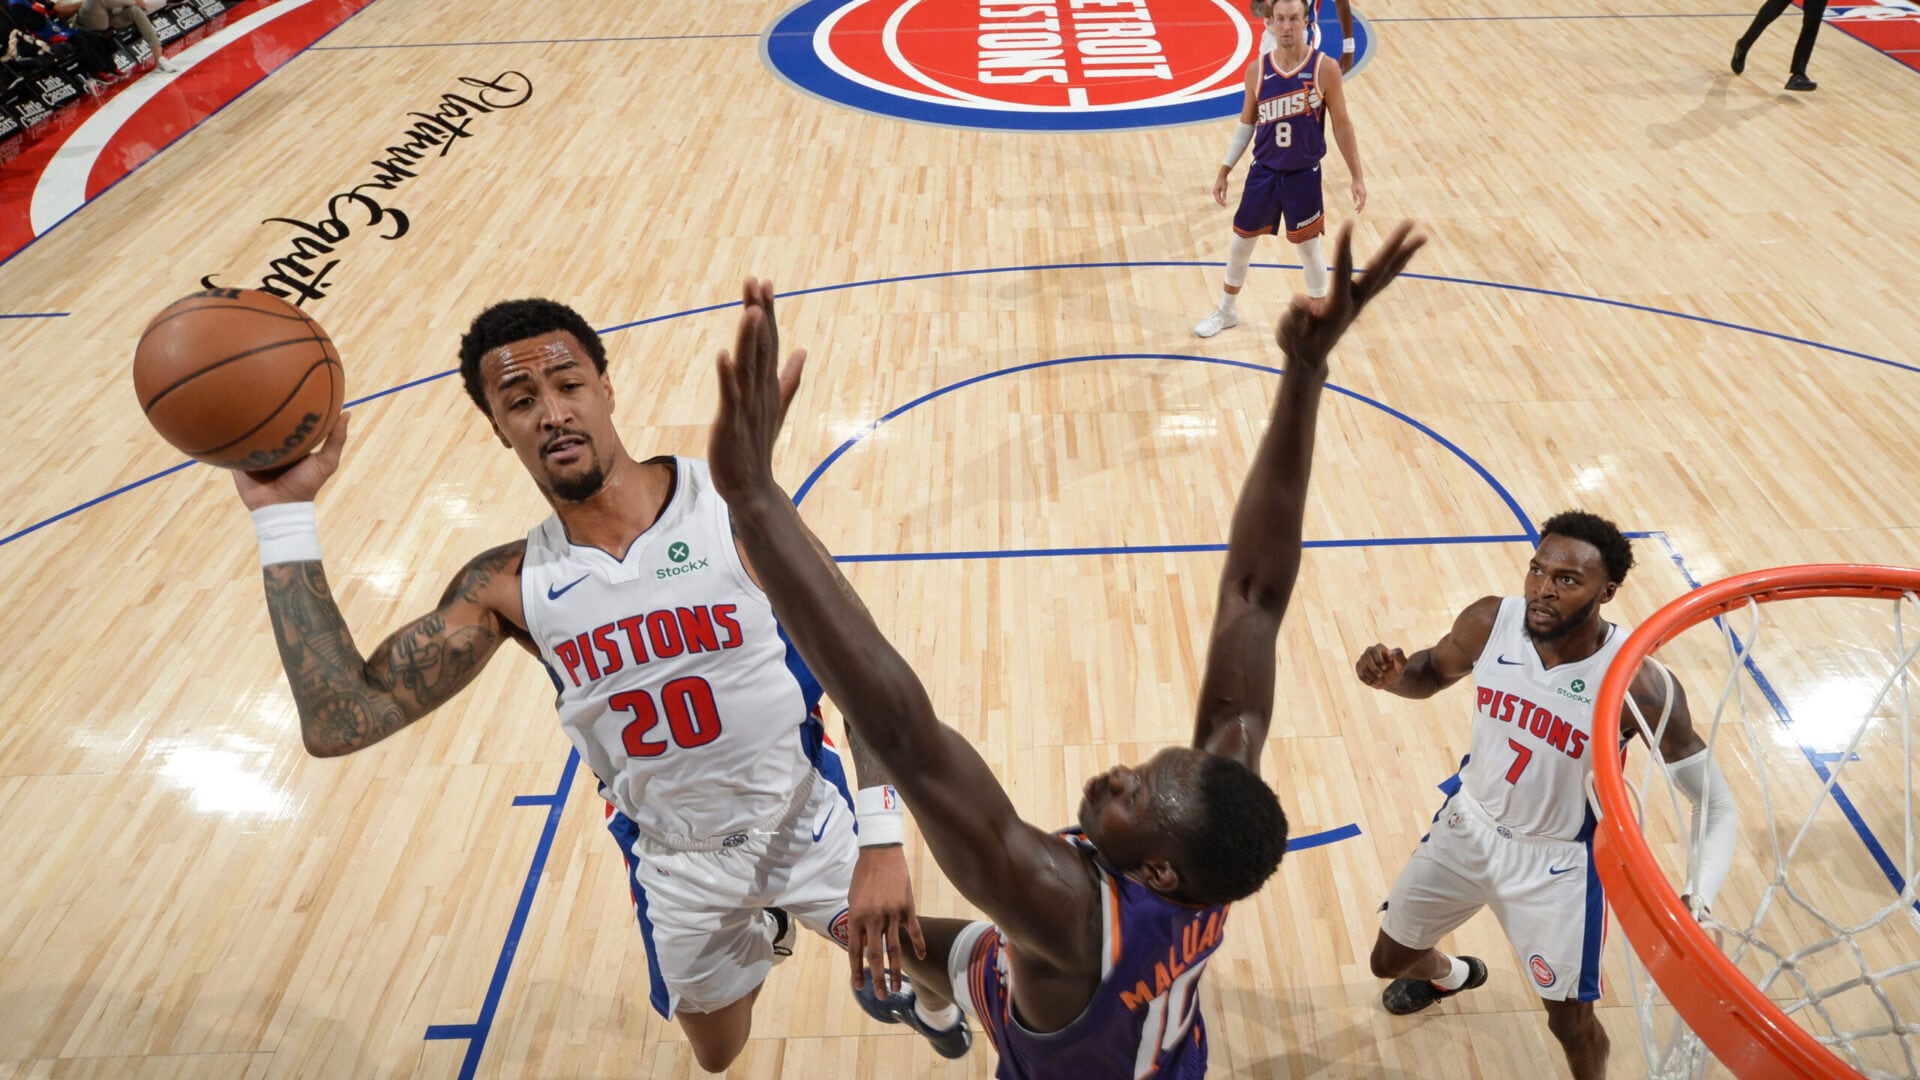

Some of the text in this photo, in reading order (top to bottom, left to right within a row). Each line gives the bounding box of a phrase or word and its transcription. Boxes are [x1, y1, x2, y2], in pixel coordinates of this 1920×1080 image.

[977, 0, 1069, 84] ISTONS
[1069, 0, 1173, 80] ETROIT
[15, 100, 46, 118] Little
[36, 75, 65, 93] Little
[41, 83, 77, 106] Caesars
[351, 71, 533, 200] Platinum
[1275, 121, 1292, 148] 8
[656, 557, 709, 579] StockX
[553, 604, 744, 688] PISTONS
[608, 676, 722, 759] 20
[1476, 685, 1590, 760] PISTONS
[1556, 687, 1591, 705] StockX
[1504, 737, 1533, 786] 7
[1119, 903, 1231, 1012] MALUA
